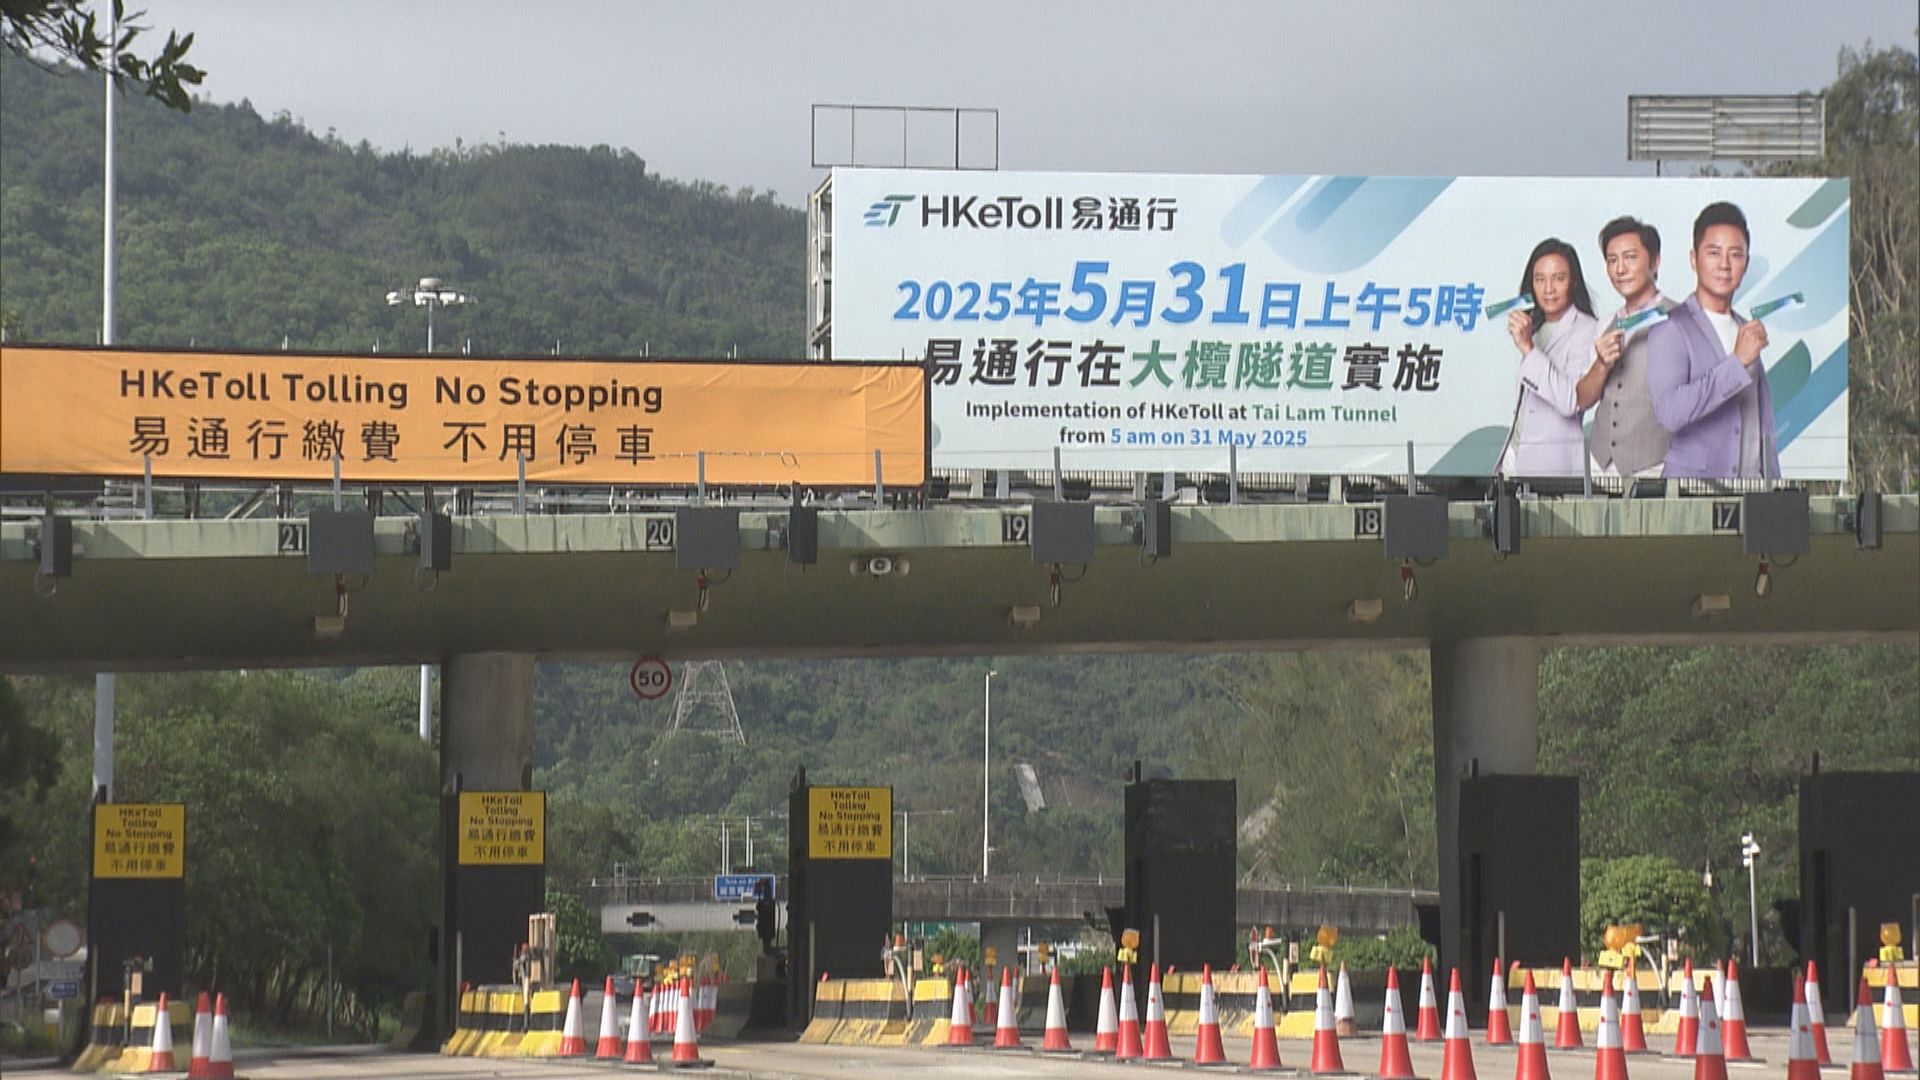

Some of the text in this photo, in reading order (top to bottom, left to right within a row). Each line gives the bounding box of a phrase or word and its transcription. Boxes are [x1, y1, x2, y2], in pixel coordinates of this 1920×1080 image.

[921, 194, 1063, 229] HKeToll
[1071, 197, 1178, 231] 易通行
[893, 260, 1486, 331] 2025年5月31日上午5時
[927, 338, 1444, 391] 易通行在大欖隧道實施
[120, 369, 662, 413] HKeToll Tolling No Stopping
[965, 401, 1397, 423] Implementation of HKeToll at Tai Lam Tunnel
[129, 416, 656, 466] 易通行繳費 不用停車
[1059, 426, 1308, 448] from 5 am on 31 May 2025
[1357, 509, 1379, 533] 18
[1715, 503, 1736, 527] 17
[282, 526, 303, 550] 21
[647, 520, 672, 546] 20
[1005, 515, 1026, 540] 19
[638, 670, 665, 687] 50
[481, 795, 522, 805] HKeToll
[831, 790, 870, 800] HKeToll
[834, 801, 866, 811] Tolling
[119, 808, 162, 817] HKeToll
[469, 816, 533, 826] No Stopping
[485, 806, 518, 816] Tolling
[819, 811, 880, 821] No Stopping
[106, 828, 172, 840] No Stopping
[122, 818, 158, 829] Tolling
